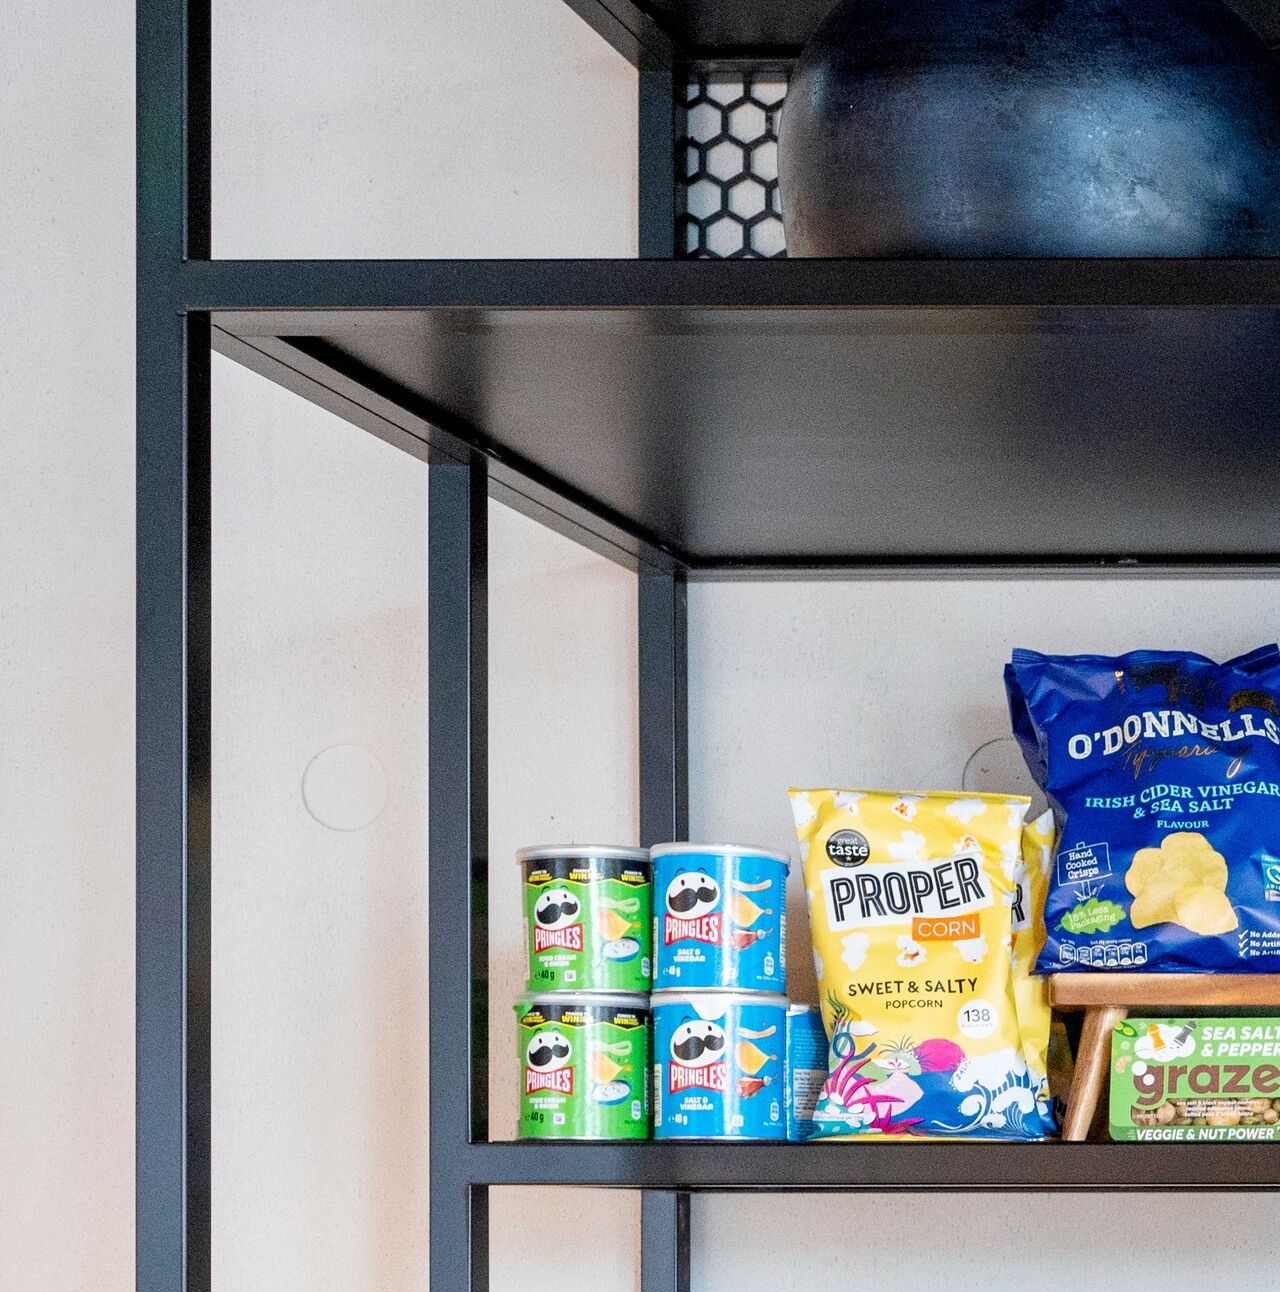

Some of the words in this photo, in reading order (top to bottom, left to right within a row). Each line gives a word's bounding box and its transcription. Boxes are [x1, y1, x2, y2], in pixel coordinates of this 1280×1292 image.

[1068, 710, 1280, 760] O'DONNELLS
[1085, 795, 1135, 810] IRISH
[1140, 784, 1192, 804] CIDER
[1133, 807, 1146, 819] &
[1150, 798, 1184, 815] SEA
[1188, 798, 1235, 814] SALT
[1156, 820, 1209, 830] FLAVOUR
[828, 845, 868, 858] taste
[1069, 849, 1093, 861] Hand
[1065, 857, 1098, 872] Cooked
[1067, 866, 1100, 880] Crisps
[830, 857, 986, 923] PROPER
[666, 916, 720, 943] PRINGLES
[917, 919, 976, 938] CORN
[535, 925, 582, 952] PRINGLES
[848, 980, 904, 997] SWEET
[908, 980, 920, 993] &
[925, 977, 978, 994] SALTY
[885, 999, 944, 1010] POPCORN
[963, 1009, 991, 1022] 138
[1201, 1027, 1236, 1041] SEA
[1200, 1044, 1214, 1058] &
[526, 1070, 572, 1093] PRINGLES
[671, 1064, 727, 1089] PRINGLES
[1132, 1062, 1280, 1105] graze
[1136, 1129, 1185, 1141] VEGGIE
[1186, 1129, 1196, 1141] &
[1199, 1128, 1227, 1140] NUT
[1228, 1128, 1275, 1140] POWER
